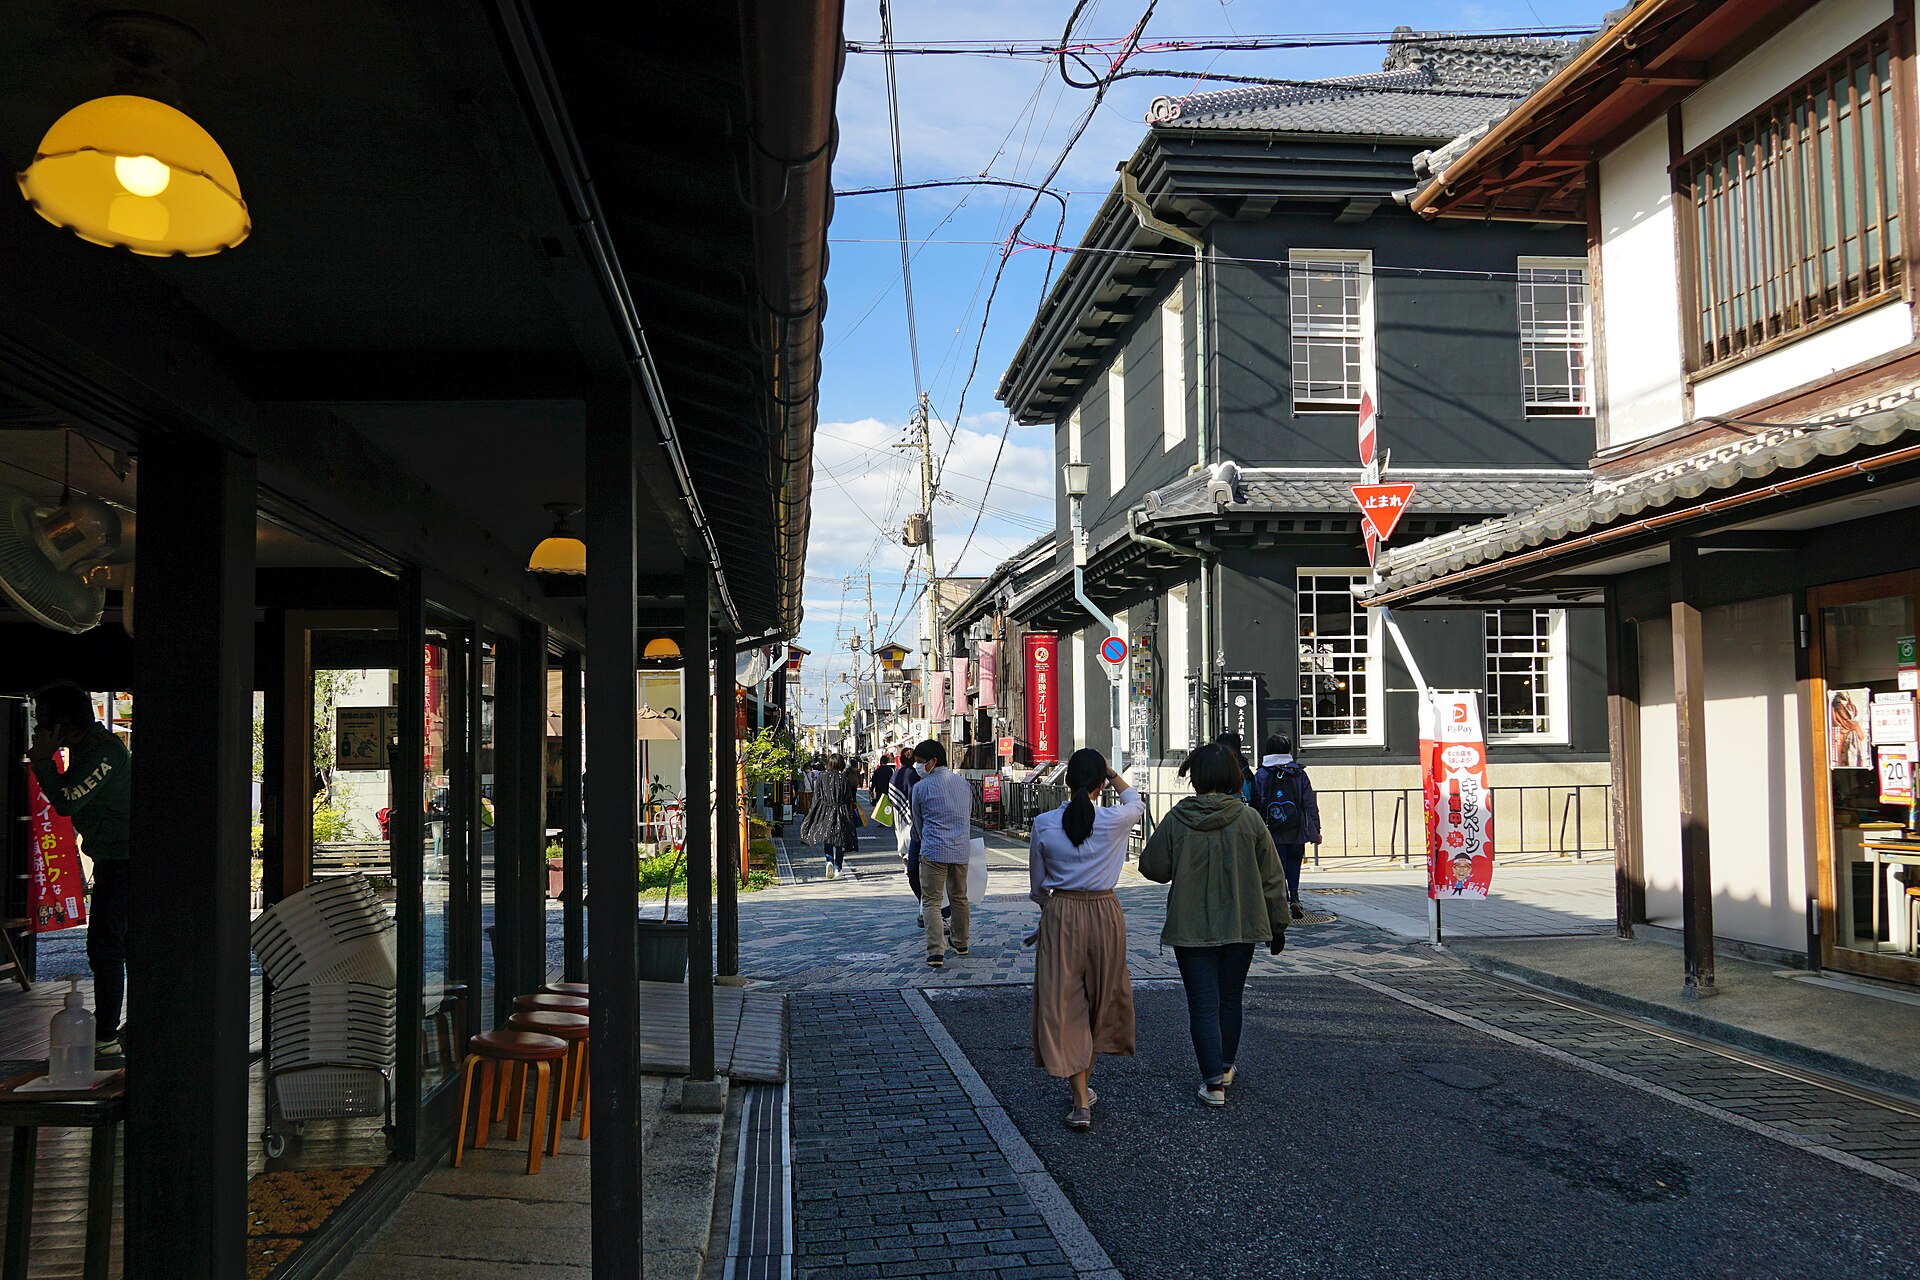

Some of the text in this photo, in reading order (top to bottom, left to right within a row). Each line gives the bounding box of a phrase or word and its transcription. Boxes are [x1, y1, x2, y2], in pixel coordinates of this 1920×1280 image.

[1364, 494, 1403, 509] 止まれ
[1038, 672, 1048, 751] 黒壁オルゴール館
[1462, 778, 1480, 854] キャンペーン
